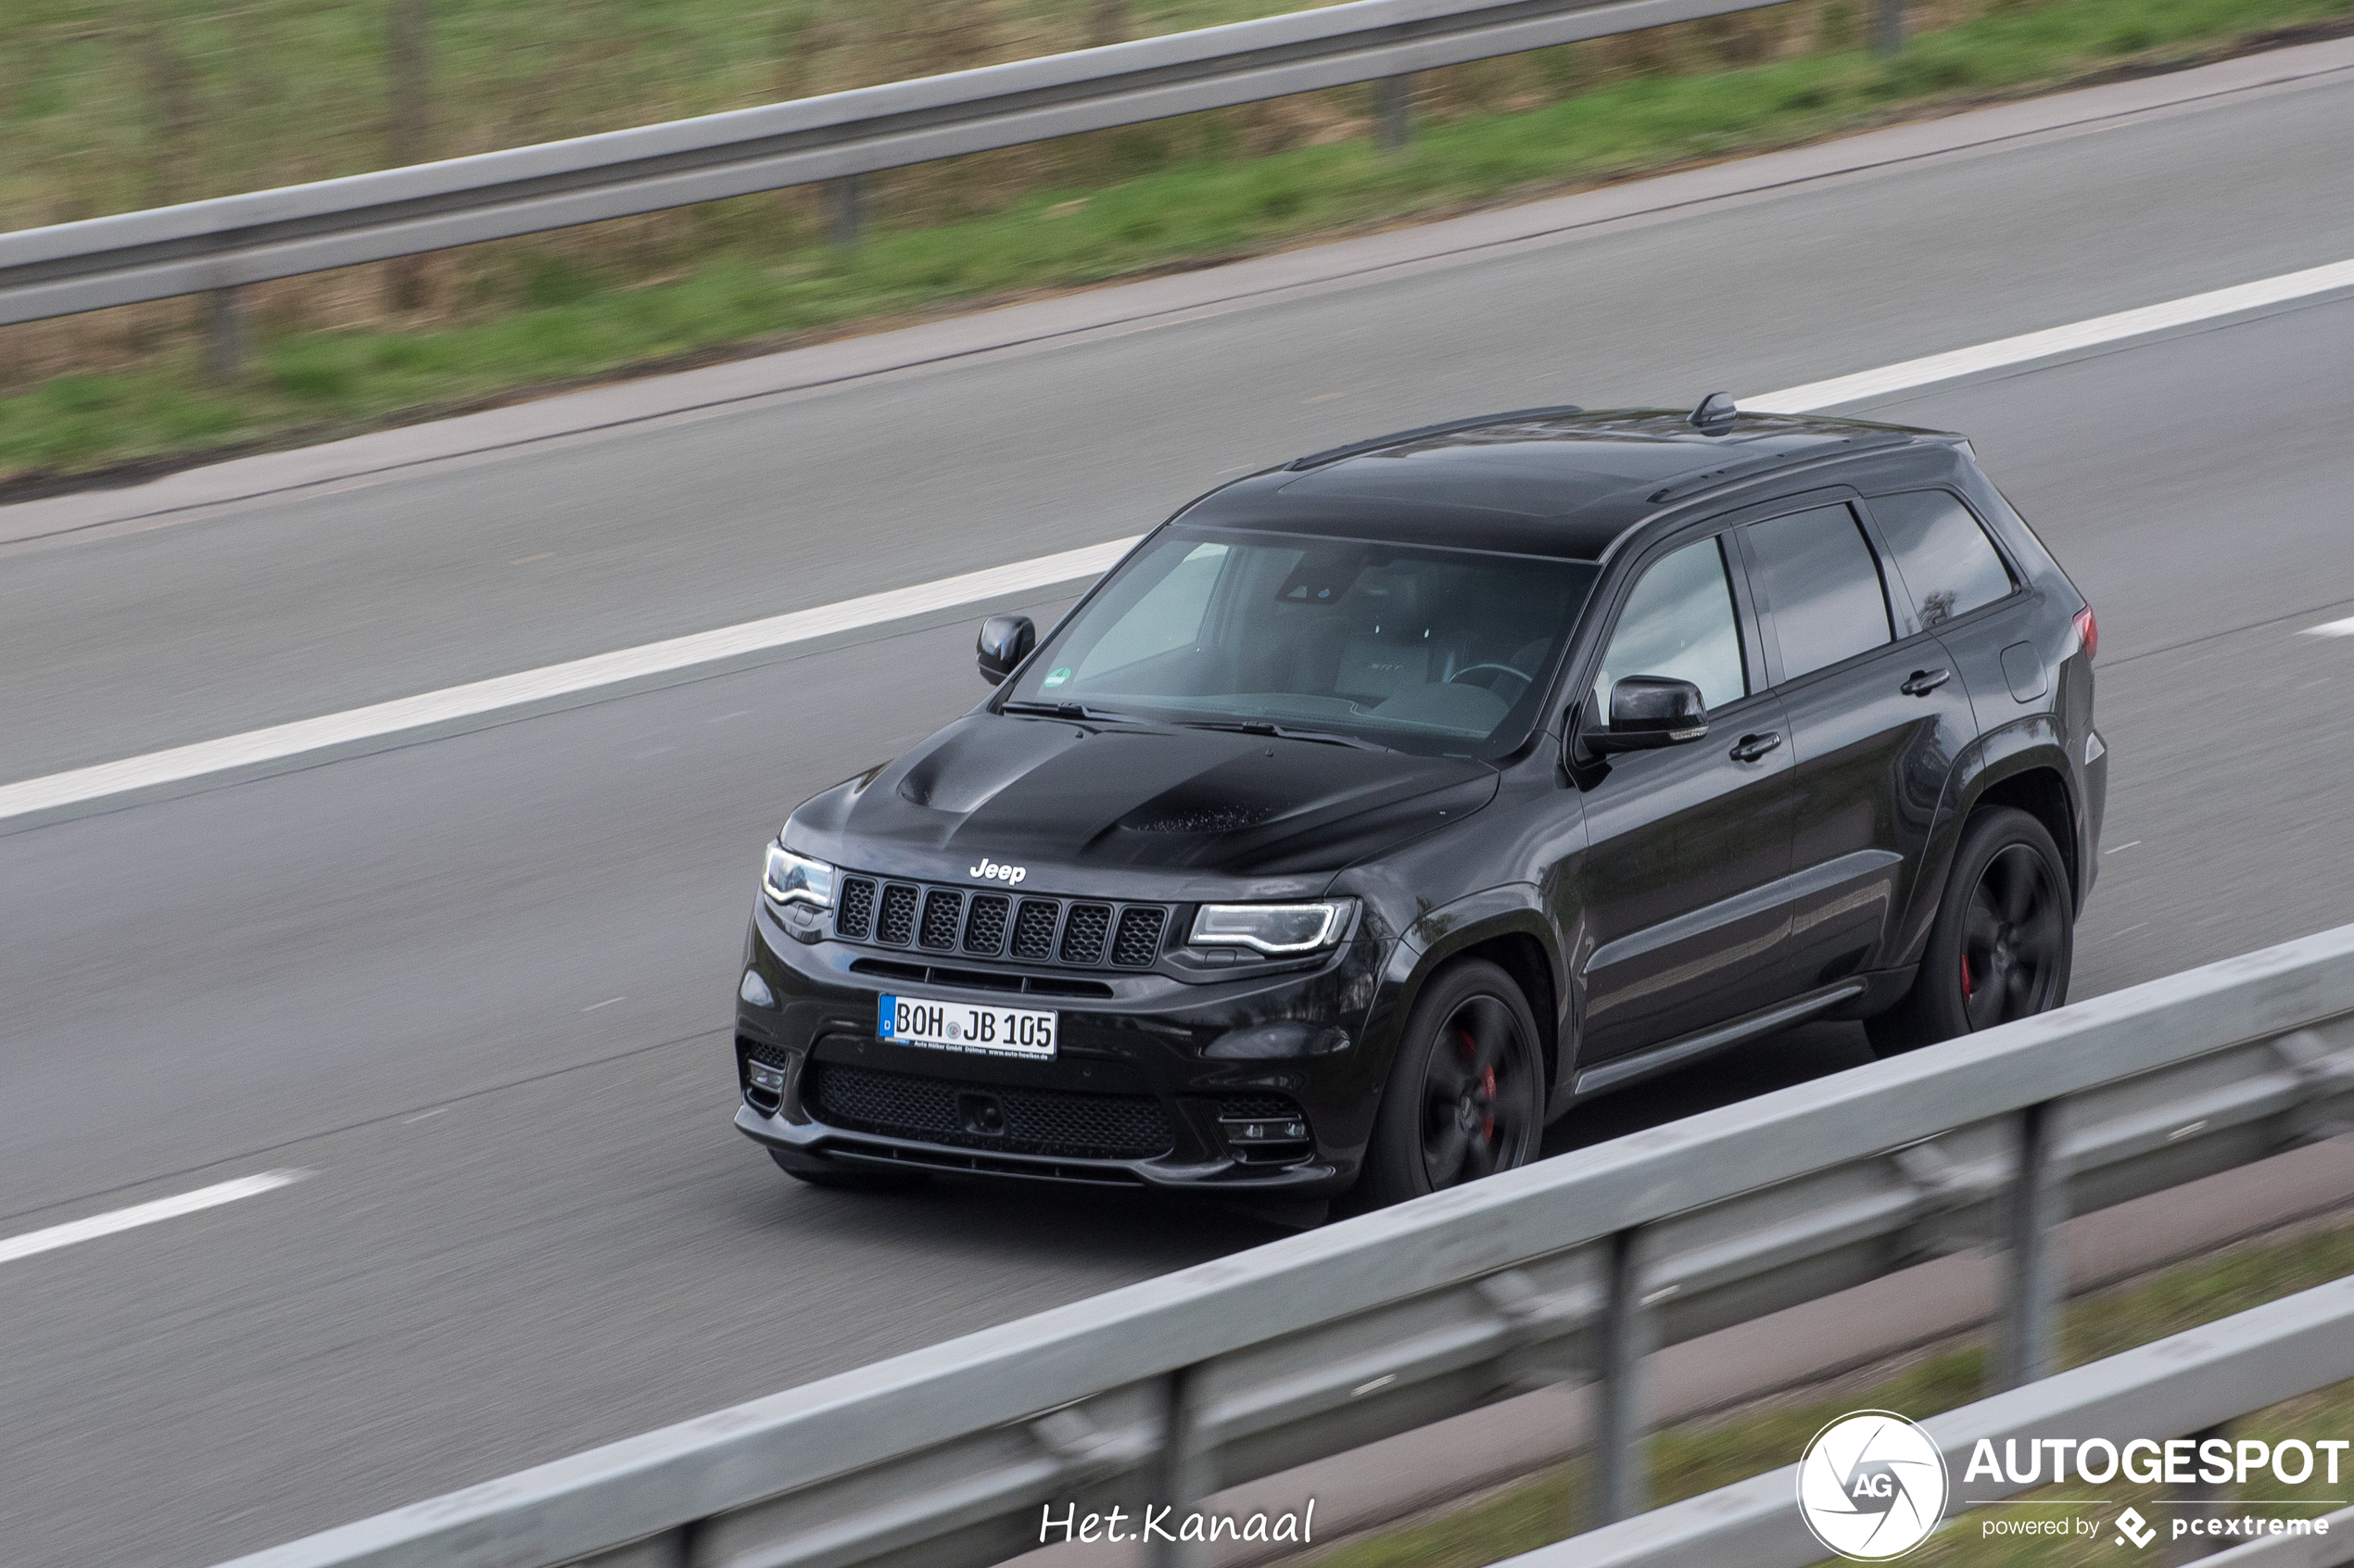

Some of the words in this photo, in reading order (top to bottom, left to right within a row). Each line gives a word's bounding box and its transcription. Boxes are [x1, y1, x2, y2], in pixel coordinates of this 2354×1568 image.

[969, 857, 1027, 886] Jeep
[884, 1020, 892, 1031] D
[897, 1004, 943, 1037] BOH
[963, 1010, 997, 1043] JB
[1002, 1015, 1053, 1048] 105
[914, 1040, 928, 1049] Auto
[946, 1044, 963, 1053] GmbH
